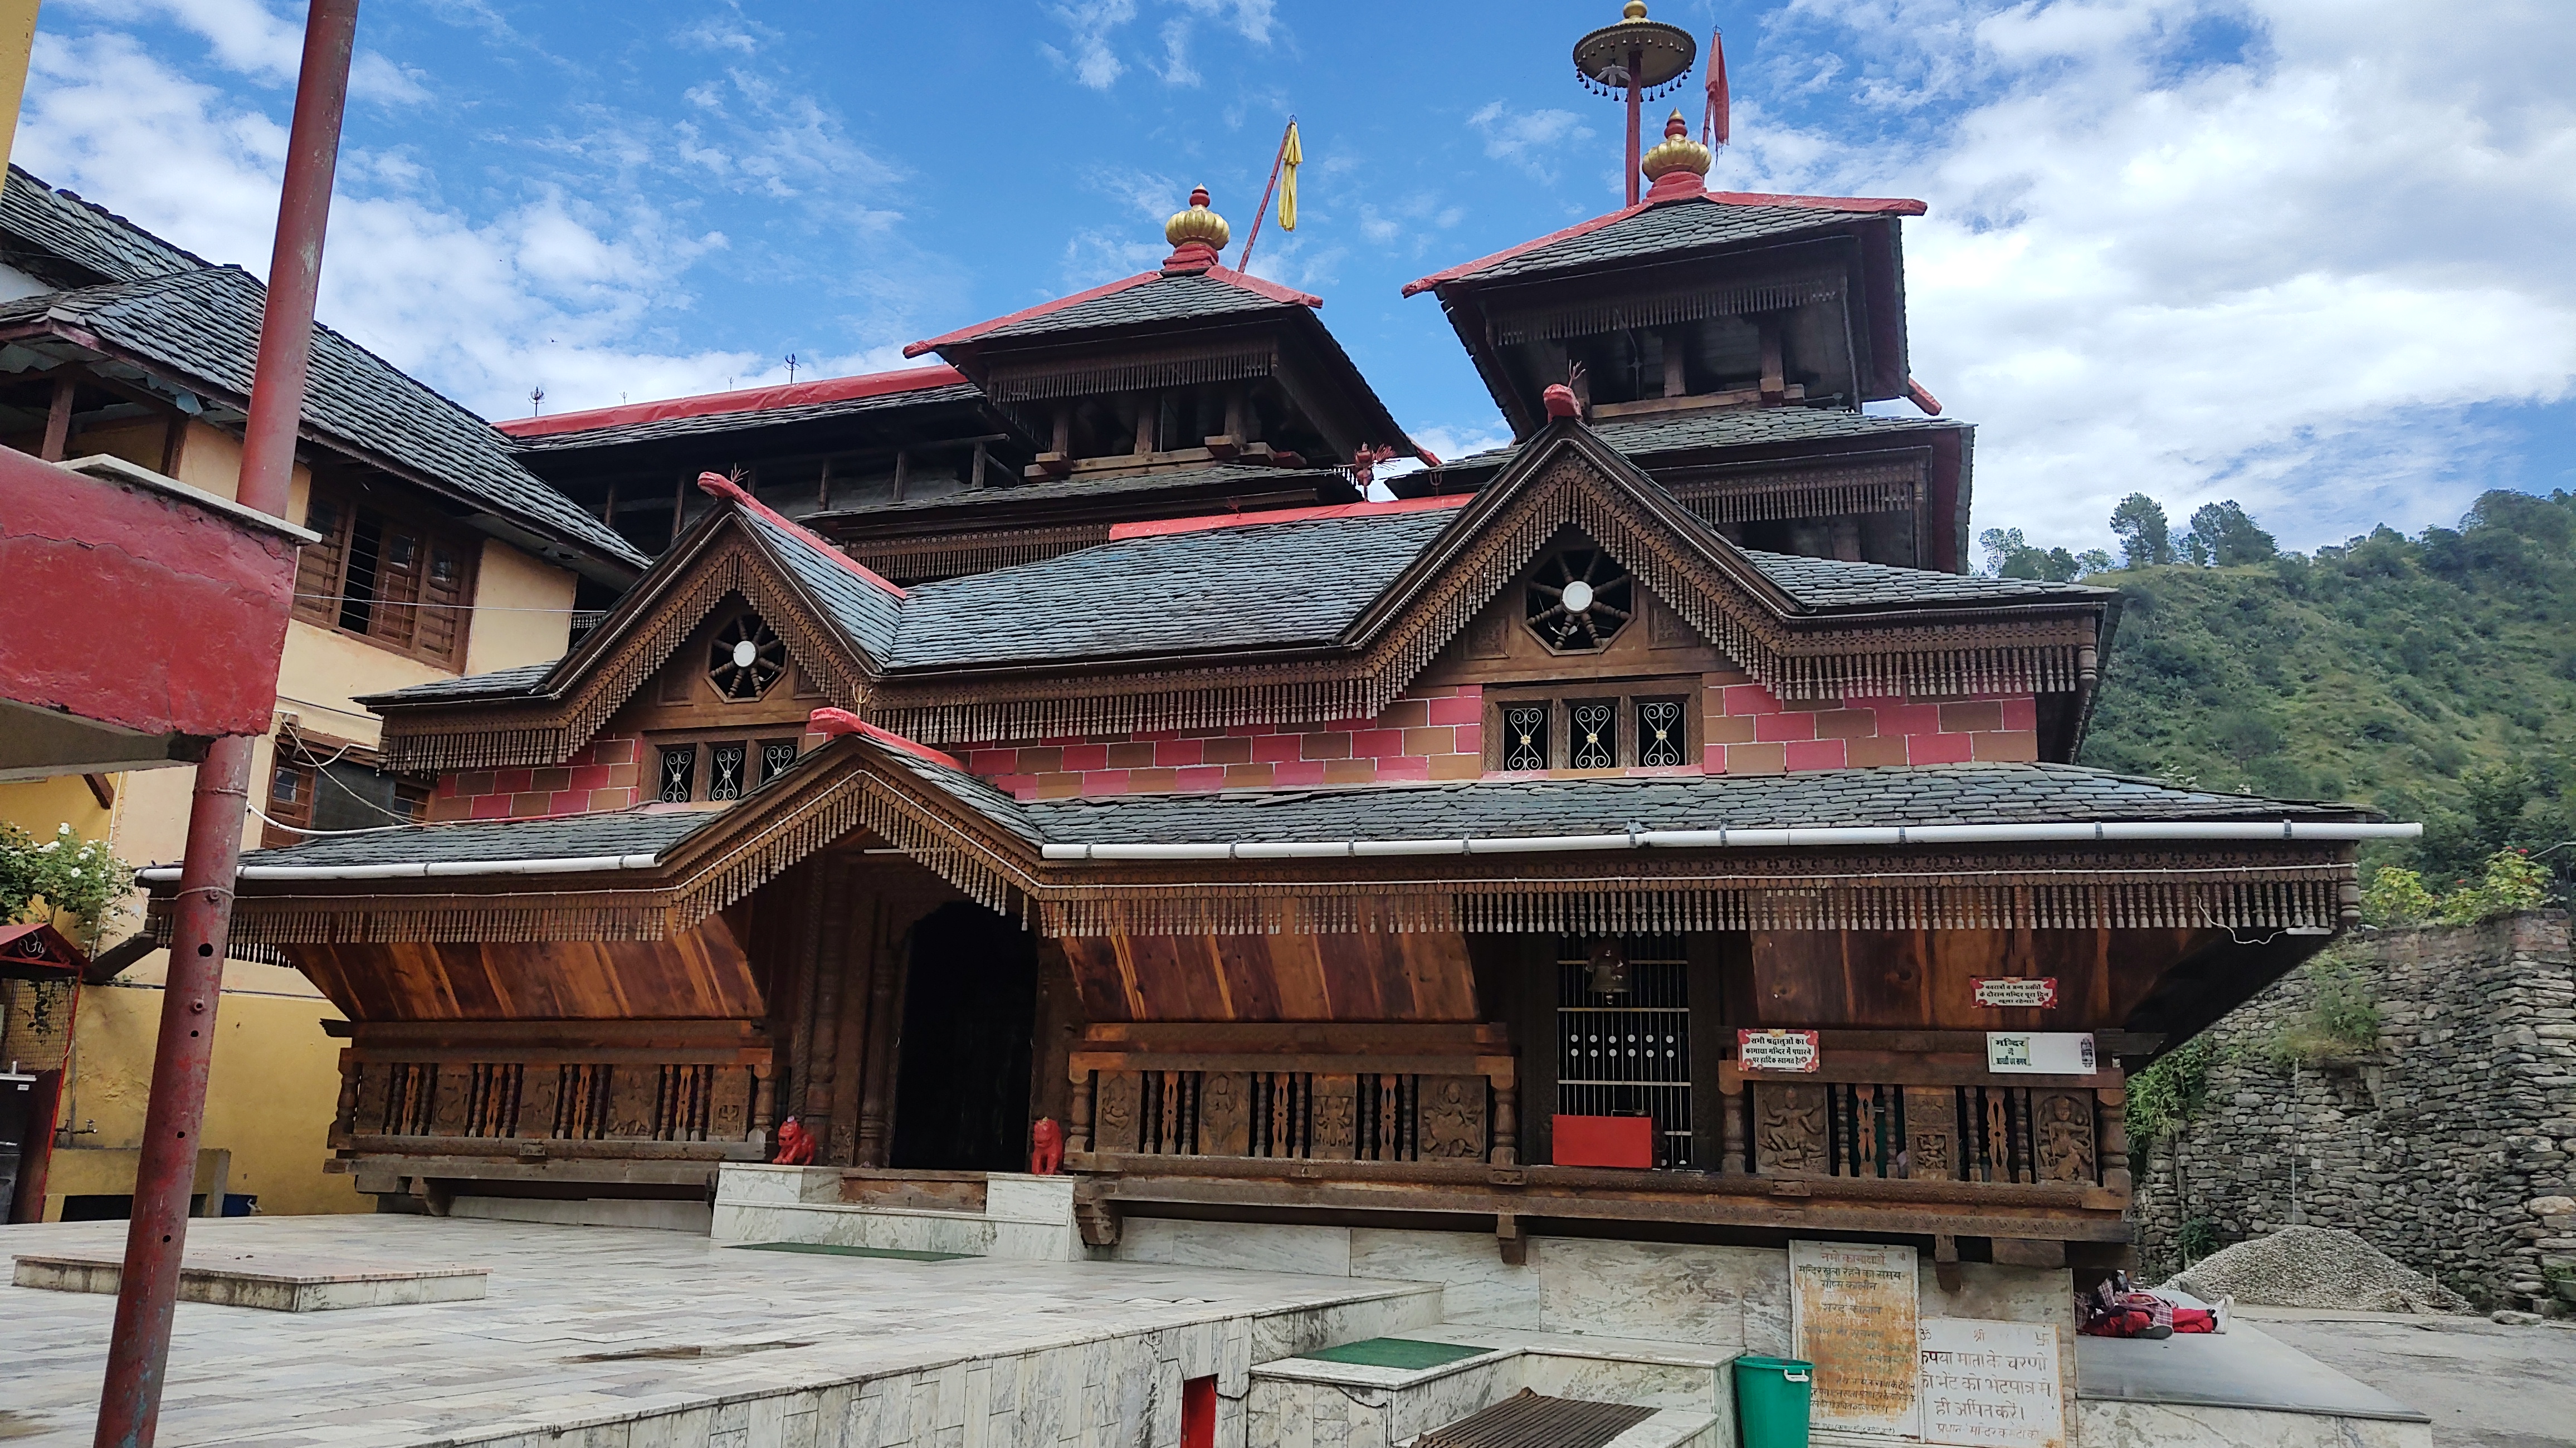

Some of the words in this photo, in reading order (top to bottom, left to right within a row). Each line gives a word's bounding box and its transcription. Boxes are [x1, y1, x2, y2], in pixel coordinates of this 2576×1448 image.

[1996, 1038, 2025, 1046] मन्दिर
[1769, 1046, 1785, 1055] मन्दिर
[1821, 1250, 1840, 1262] नमो
[1841, 1266, 1861, 1278] रहने
[1862, 1270, 1874, 1278] का
[1845, 1279, 1877, 1290] कालीन
[1973, 1329, 1984, 1342] श्री
[1957, 1352, 1984, 1368] माता
[1987, 1349, 2003, 1369] के
[1962, 1372, 1982, 1392] को
[1934, 1397, 1951, 1417] ही
